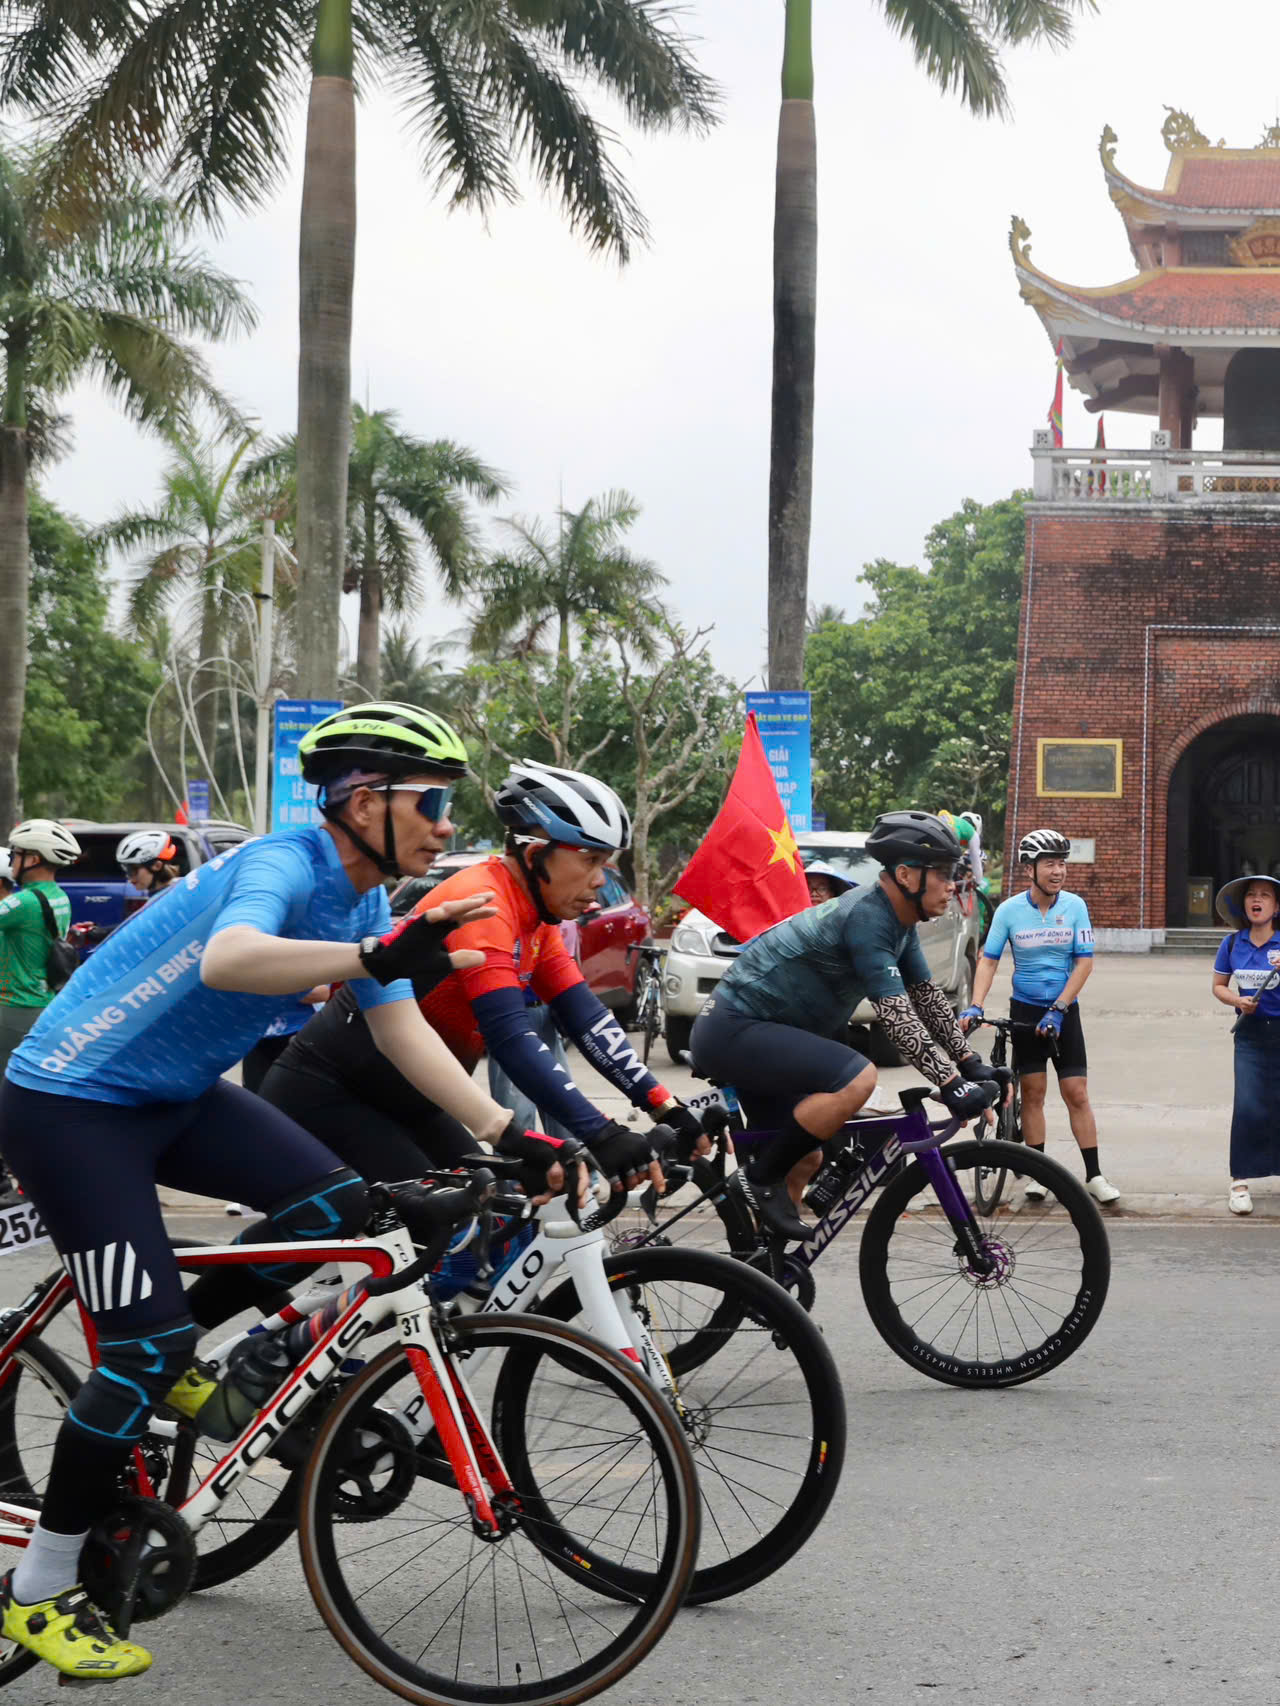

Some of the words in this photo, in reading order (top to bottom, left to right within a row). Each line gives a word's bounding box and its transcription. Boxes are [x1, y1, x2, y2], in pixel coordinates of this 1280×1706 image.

[768, 745, 789, 762] GIẢI
[39, 1006, 127, 1072] QUẢNG
[120, 976, 168, 1009] TRỊ
[156, 939, 205, 984] BIKE
[589, 1013, 648, 1083] IAM
[953, 1081, 980, 1098] UAE
[802, 1133, 903, 1261] MISSILE
[0, 1207, 48, 1249] 252
[401, 1314, 421, 1338] 3T
[1063, 1289, 1092, 1335] KESTREL
[640, 1334, 672, 1387] PINARELLO
[967, 1366, 1013, 1376] WHEELS
[1019, 1339, 1062, 1369] CARBON
[210, 1312, 374, 1501] FOCUS
